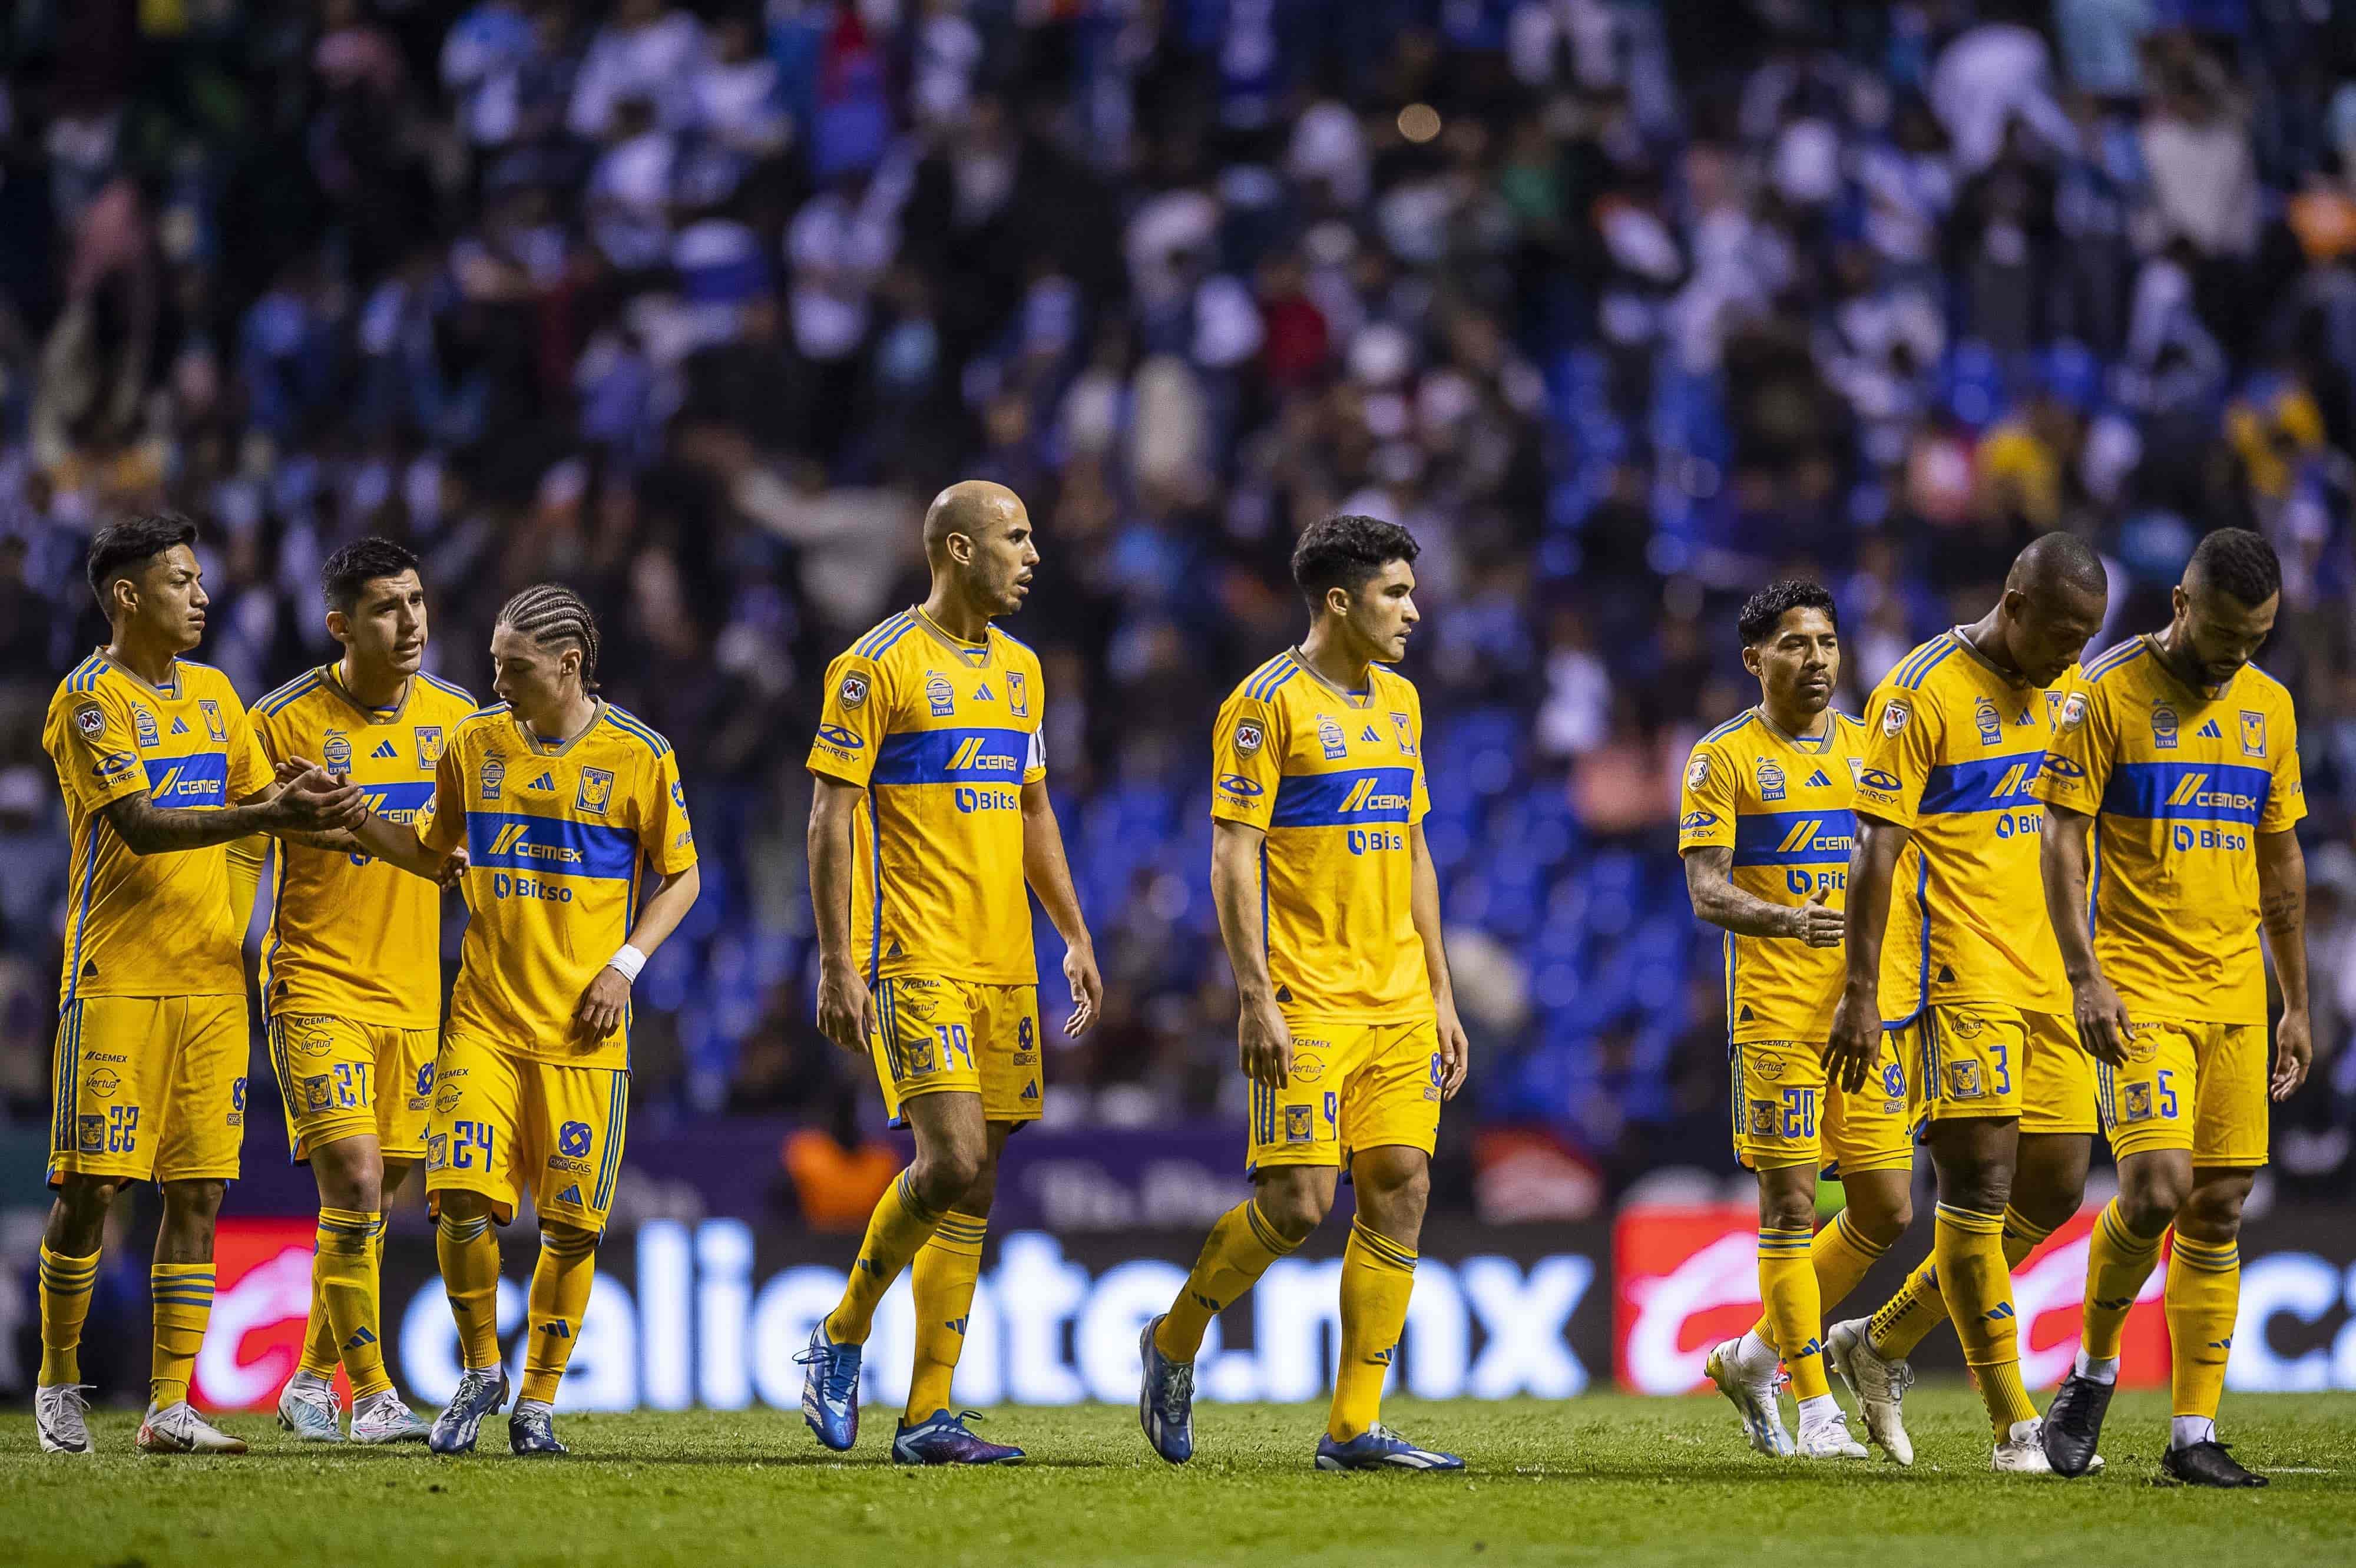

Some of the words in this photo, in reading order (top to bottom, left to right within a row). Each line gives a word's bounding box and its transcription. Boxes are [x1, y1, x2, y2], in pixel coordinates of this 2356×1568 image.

[177, 779, 221, 795] CEME
[1857, 787, 1898, 805] HIREY
[2196, 792, 2257, 811] CEMEX
[515, 842, 584, 863] CEMEX
[1813, 836, 1854, 851] CEM
[515, 878, 573, 903] Bitso
[1818, 871, 1845, 891] Bit
[301, 1040, 331, 1051] Vertua
[935, 1024, 973, 1071] 19
[1297, 1038, 1331, 1048] CEMEX
[94, 1053, 128, 1063] CEMEX
[1753, 1060, 1783, 1072] Vertua
[440, 1069, 469, 1078] CEMEX
[1989, 1045, 2011, 1094] 3
[85, 1077, 117, 1089] Vertua
[333, 1062, 368, 1107] 27
[2158, 1070, 2179, 1119] 5
[1782, 1089, 1815, 1139] 20
[108, 1105, 140, 1153] 22
[452, 1120, 494, 1173] 24
